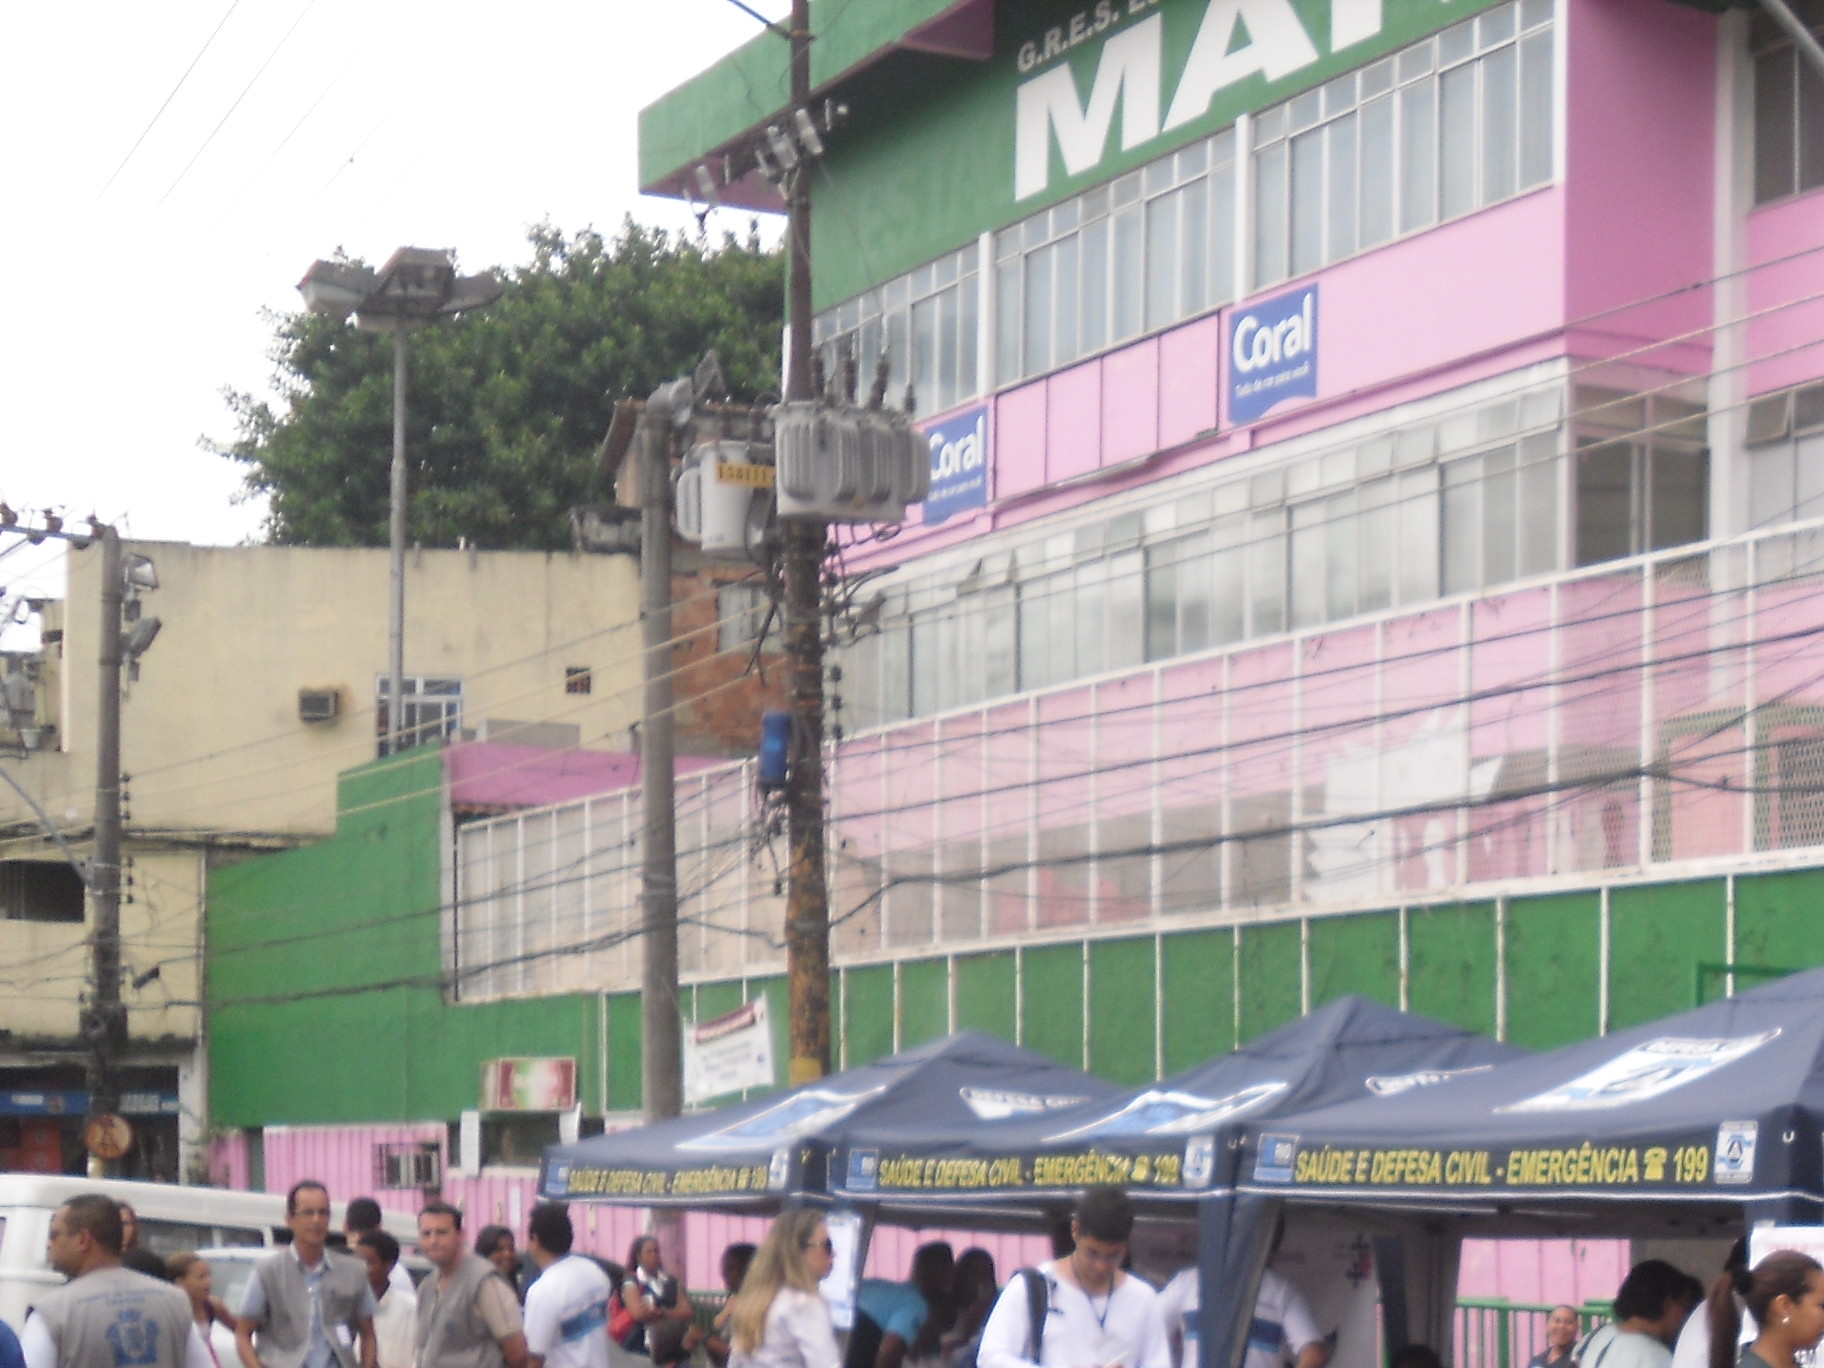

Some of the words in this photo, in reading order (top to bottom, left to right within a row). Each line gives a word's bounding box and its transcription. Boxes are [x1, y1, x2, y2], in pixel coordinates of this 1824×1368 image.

[1232, 292, 1313, 374] Coral
[878, 1153, 923, 1187] SAÚDE
[923, 1159, 935, 1187] E
[935, 1158, 988, 1187] DEFESA
[989, 1157, 1023, 1187] CIVIL
[1033, 1149, 1132, 1186] EMERGÊNCIA
[1152, 1154, 1180, 1186] 199
[1295, 1145, 1355, 1184] SAÚDE
[1355, 1150, 1370, 1183] E
[1370, 1150, 1441, 1184] DEFESA
[1445, 1150, 1493, 1185] CIVIL
[1506, 1140, 1640, 1184] EMERGÊNCIA
[1673, 1146, 1709, 1182] 199
